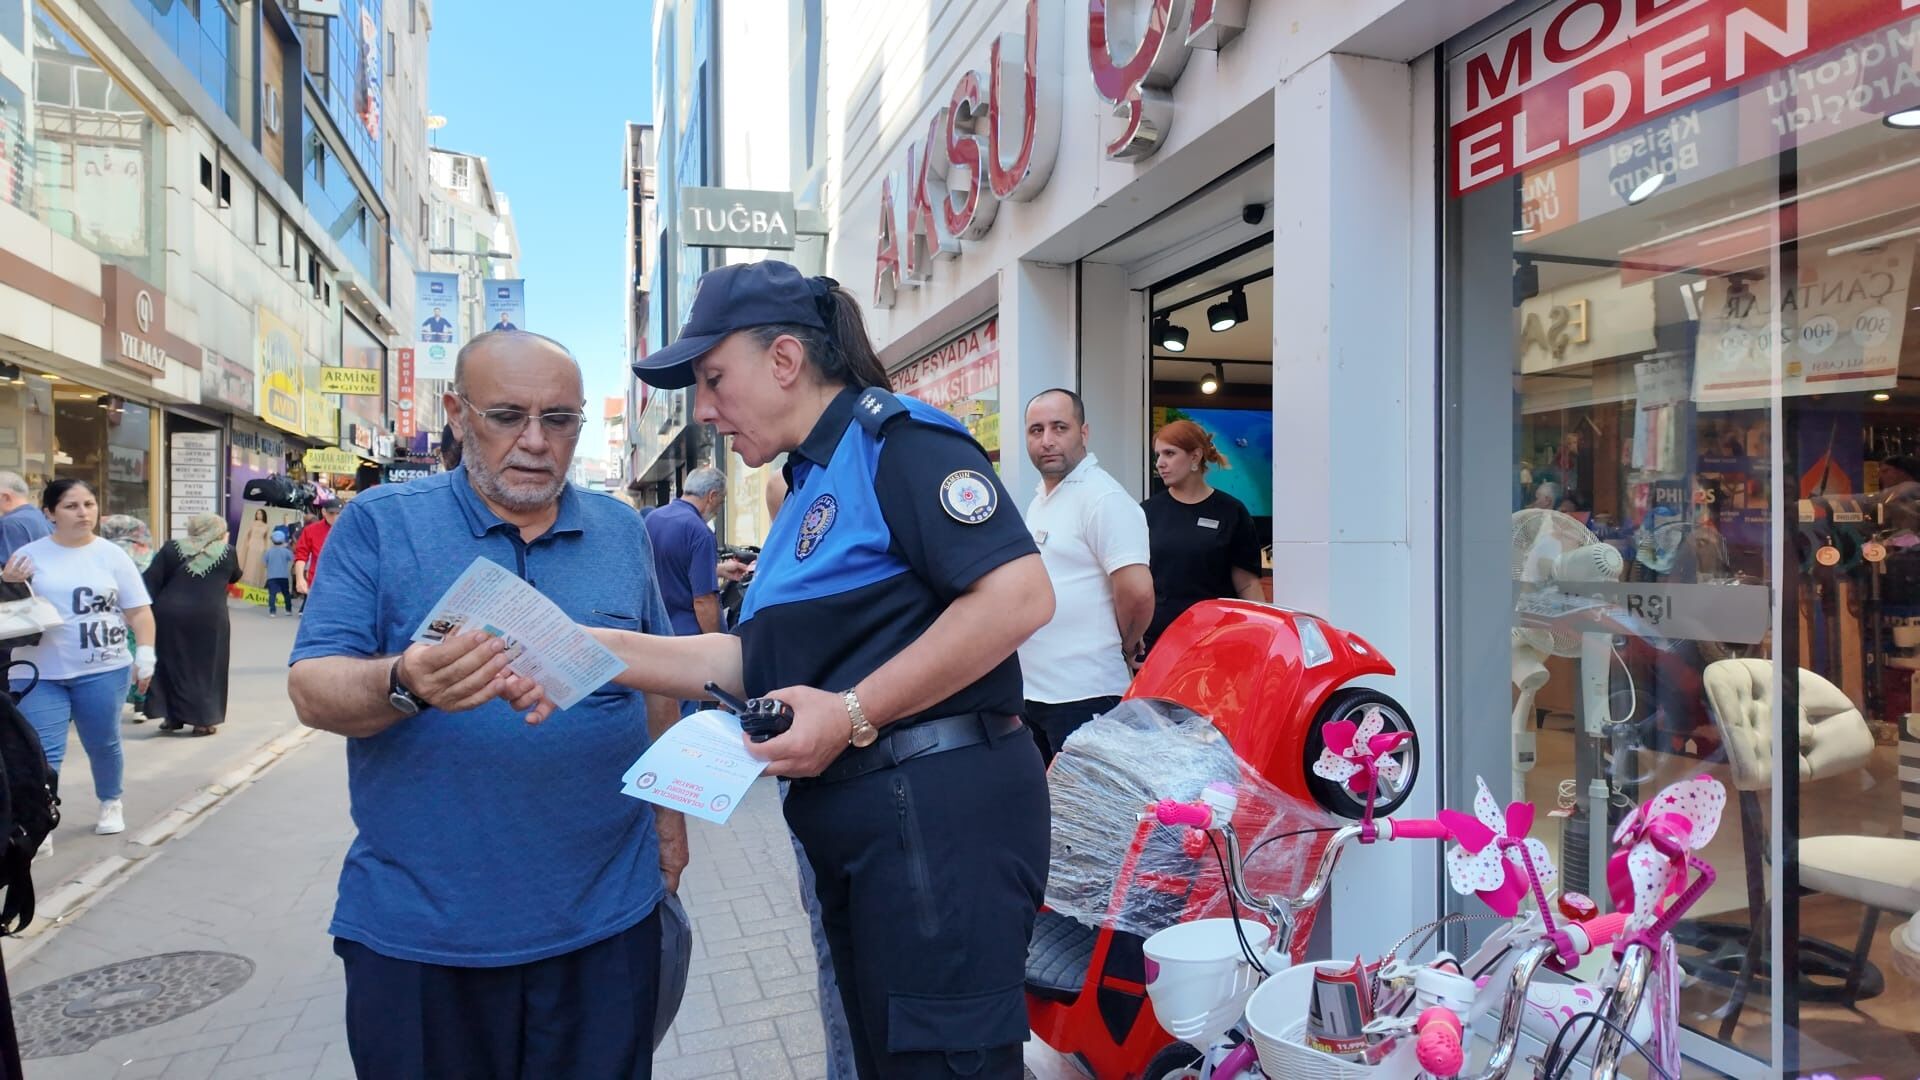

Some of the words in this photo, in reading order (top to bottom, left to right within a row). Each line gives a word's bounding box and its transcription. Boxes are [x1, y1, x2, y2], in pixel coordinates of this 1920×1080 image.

[1466, 0, 1690, 112] MO
[1459, 0, 1808, 191] ELDEN
[873, 0, 1050, 308] AKSU
[688, 202, 788, 235] TUĞBA
[120, 331, 166, 371] YILMAZ
[324, 370, 377, 384] ARMİNE
[889, 363, 919, 394] EYAZ
[943, 471, 970, 490] SAMSUN
